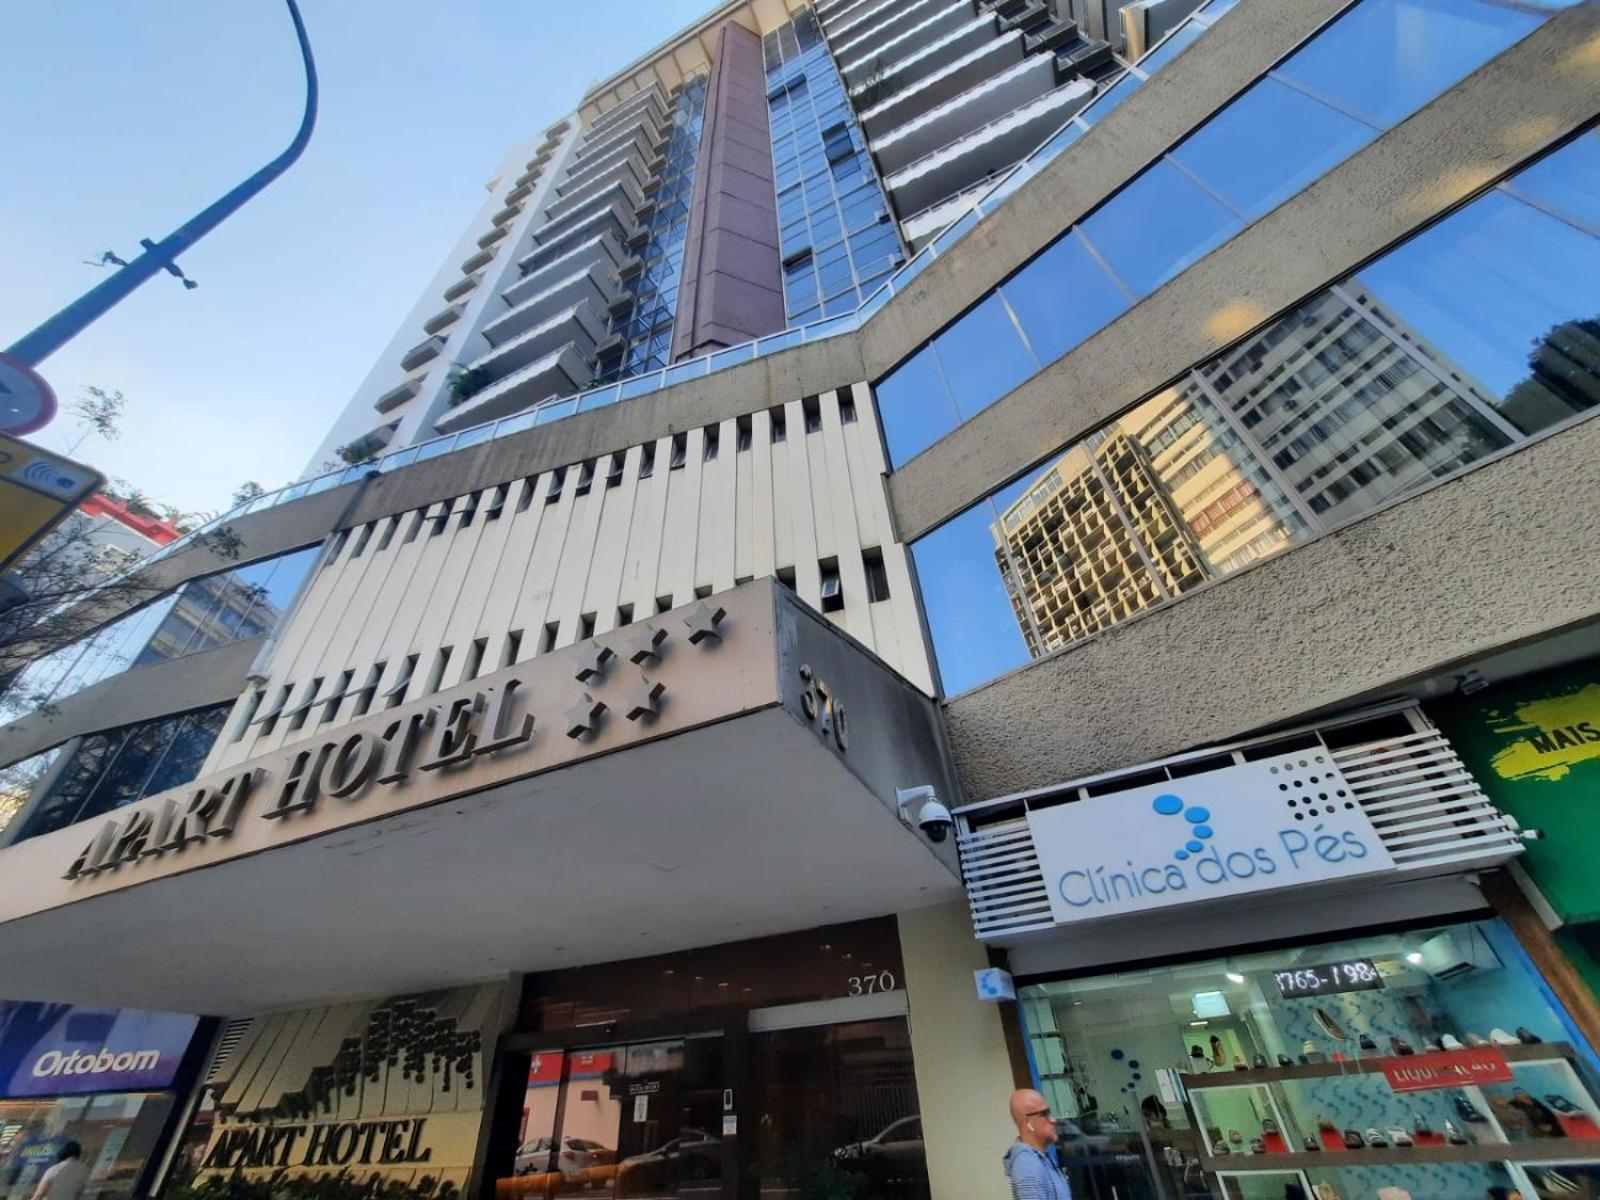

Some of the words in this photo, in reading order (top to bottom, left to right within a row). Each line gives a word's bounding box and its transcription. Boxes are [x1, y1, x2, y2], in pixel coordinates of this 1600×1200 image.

[1529, 721, 1600, 754] MAIS
[61, 767, 268, 880] APART
[260, 678, 536, 820] HOTEL
[1058, 866, 1187, 907] Clínica
[1196, 845, 1277, 884] dos
[1278, 823, 1367, 869] Pés
[848, 971, 895, 997] 370
[32, 1048, 160, 1077] Ortobom
[202, 1125, 306, 1168] APART
[302, 1118, 433, 1166] HOTEL
